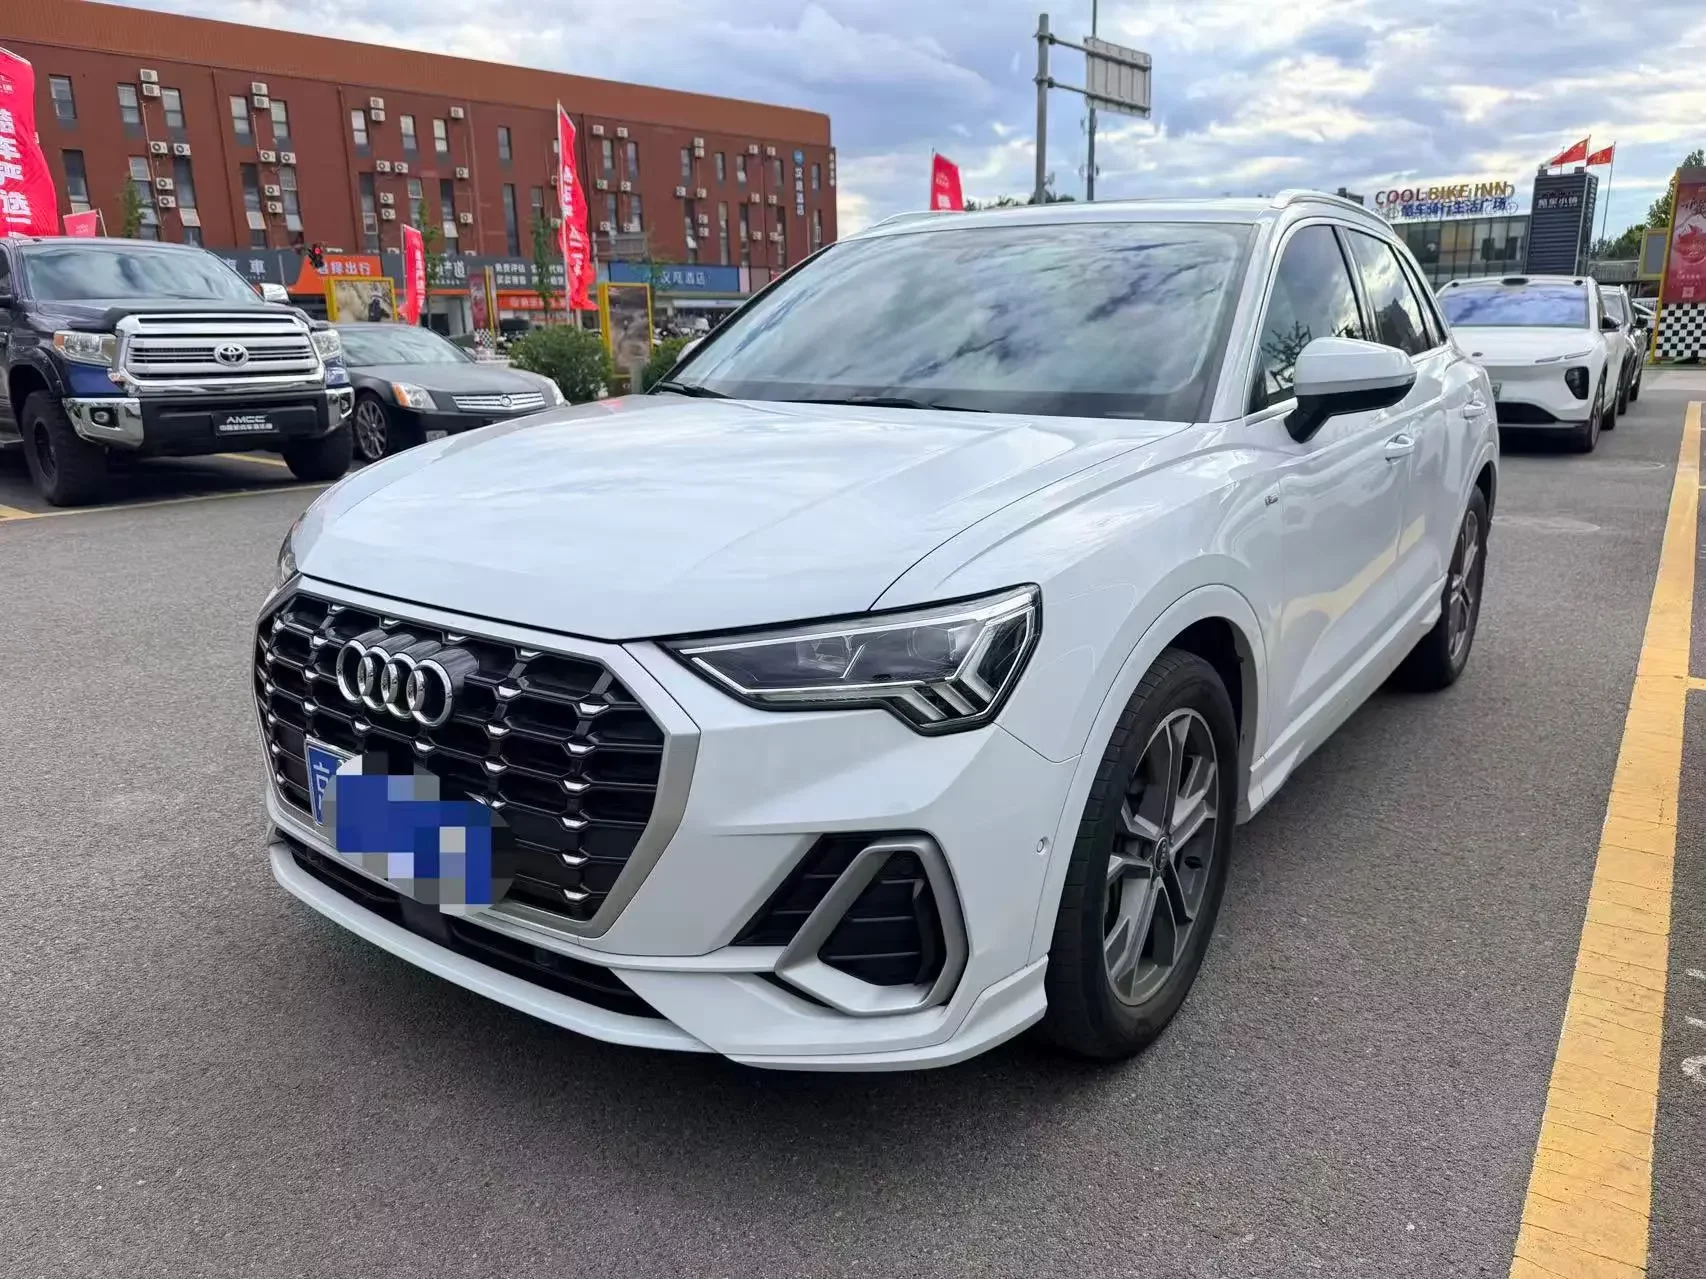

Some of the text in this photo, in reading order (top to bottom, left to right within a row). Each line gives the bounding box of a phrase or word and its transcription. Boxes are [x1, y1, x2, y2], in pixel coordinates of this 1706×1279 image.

[1375, 181, 1508, 206] COOL BIKE INN
